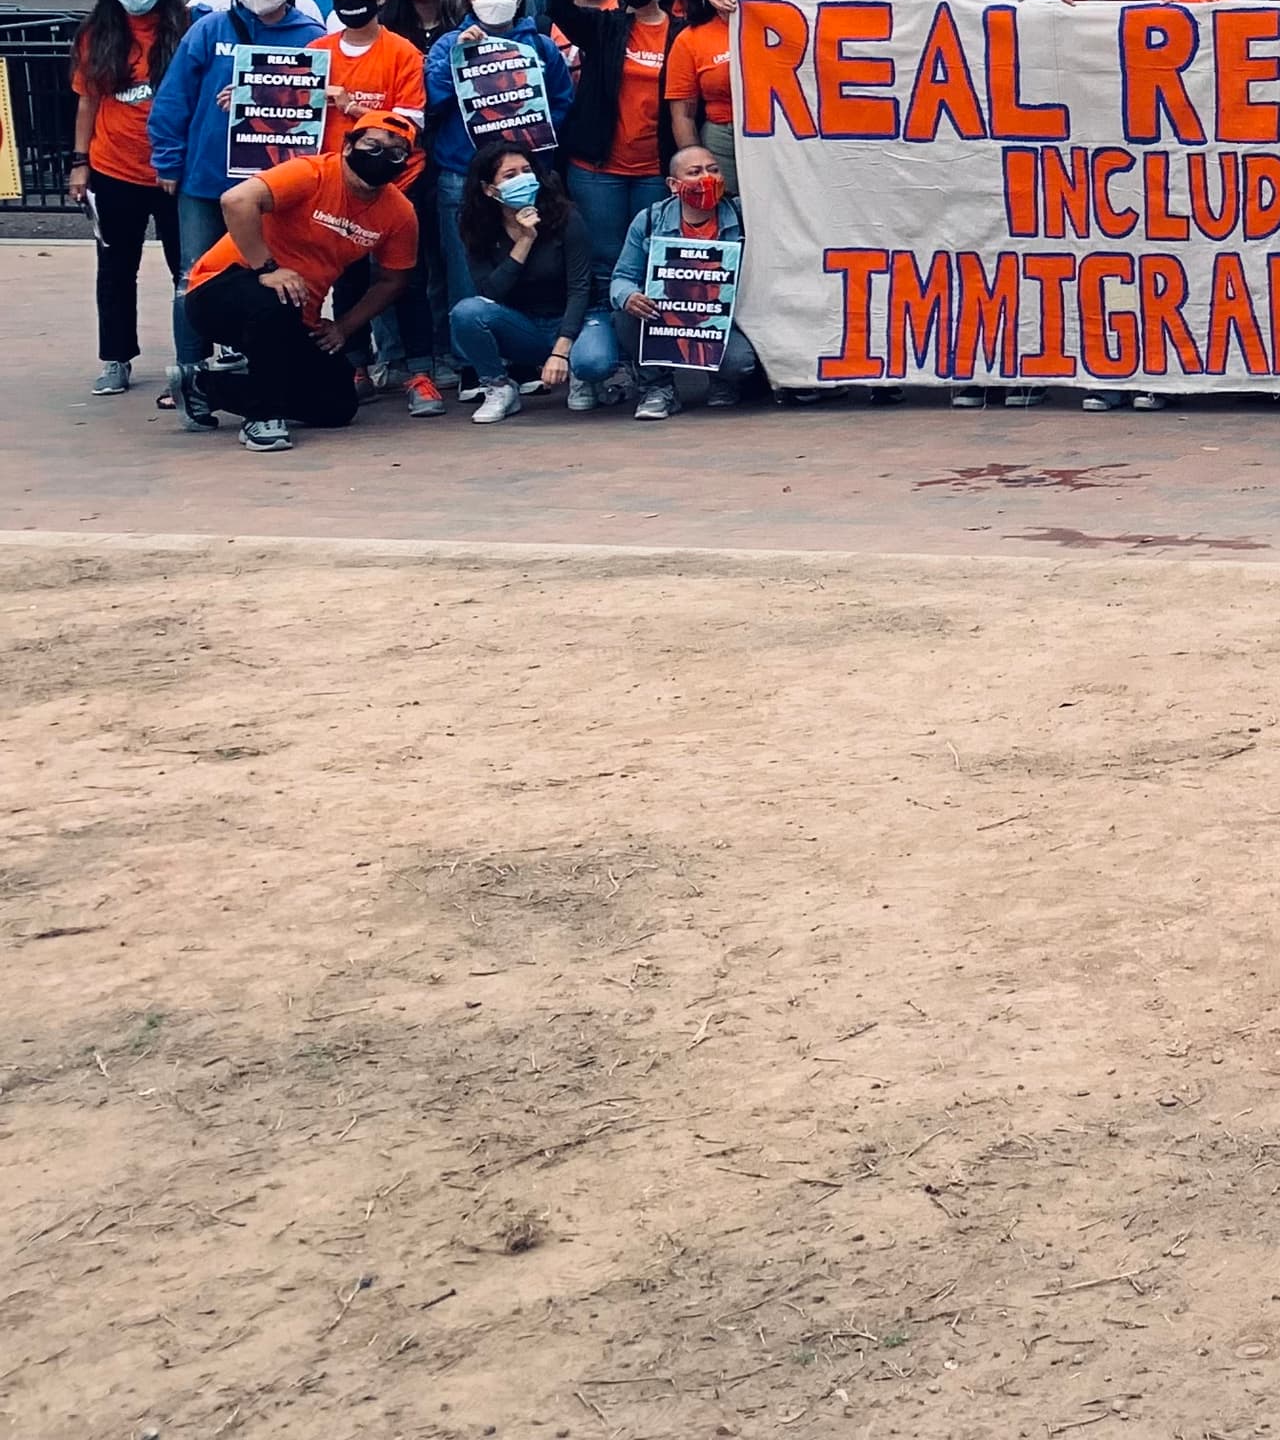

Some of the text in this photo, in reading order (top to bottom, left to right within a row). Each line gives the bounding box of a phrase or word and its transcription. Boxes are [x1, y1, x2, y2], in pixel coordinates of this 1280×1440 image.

[478, 43, 507, 54] REAL
[268, 55, 298, 64] REAL
[462, 58, 532, 78] RECOVERY
[244, 74, 320, 86] RECOVERY
[472, 88, 534, 108] INCLUDES
[245, 107, 313, 118] INCLUDES
[474, 112, 543, 134] IMMIGRANTS
[236, 134, 315, 145] IMMIGRANTS
[680, 250, 709, 259] REAL
[658, 268, 730, 281] RECOVERY
[659, 301, 722, 313] INCLUDES
[649, 326, 722, 339] IMMIGRANTS
